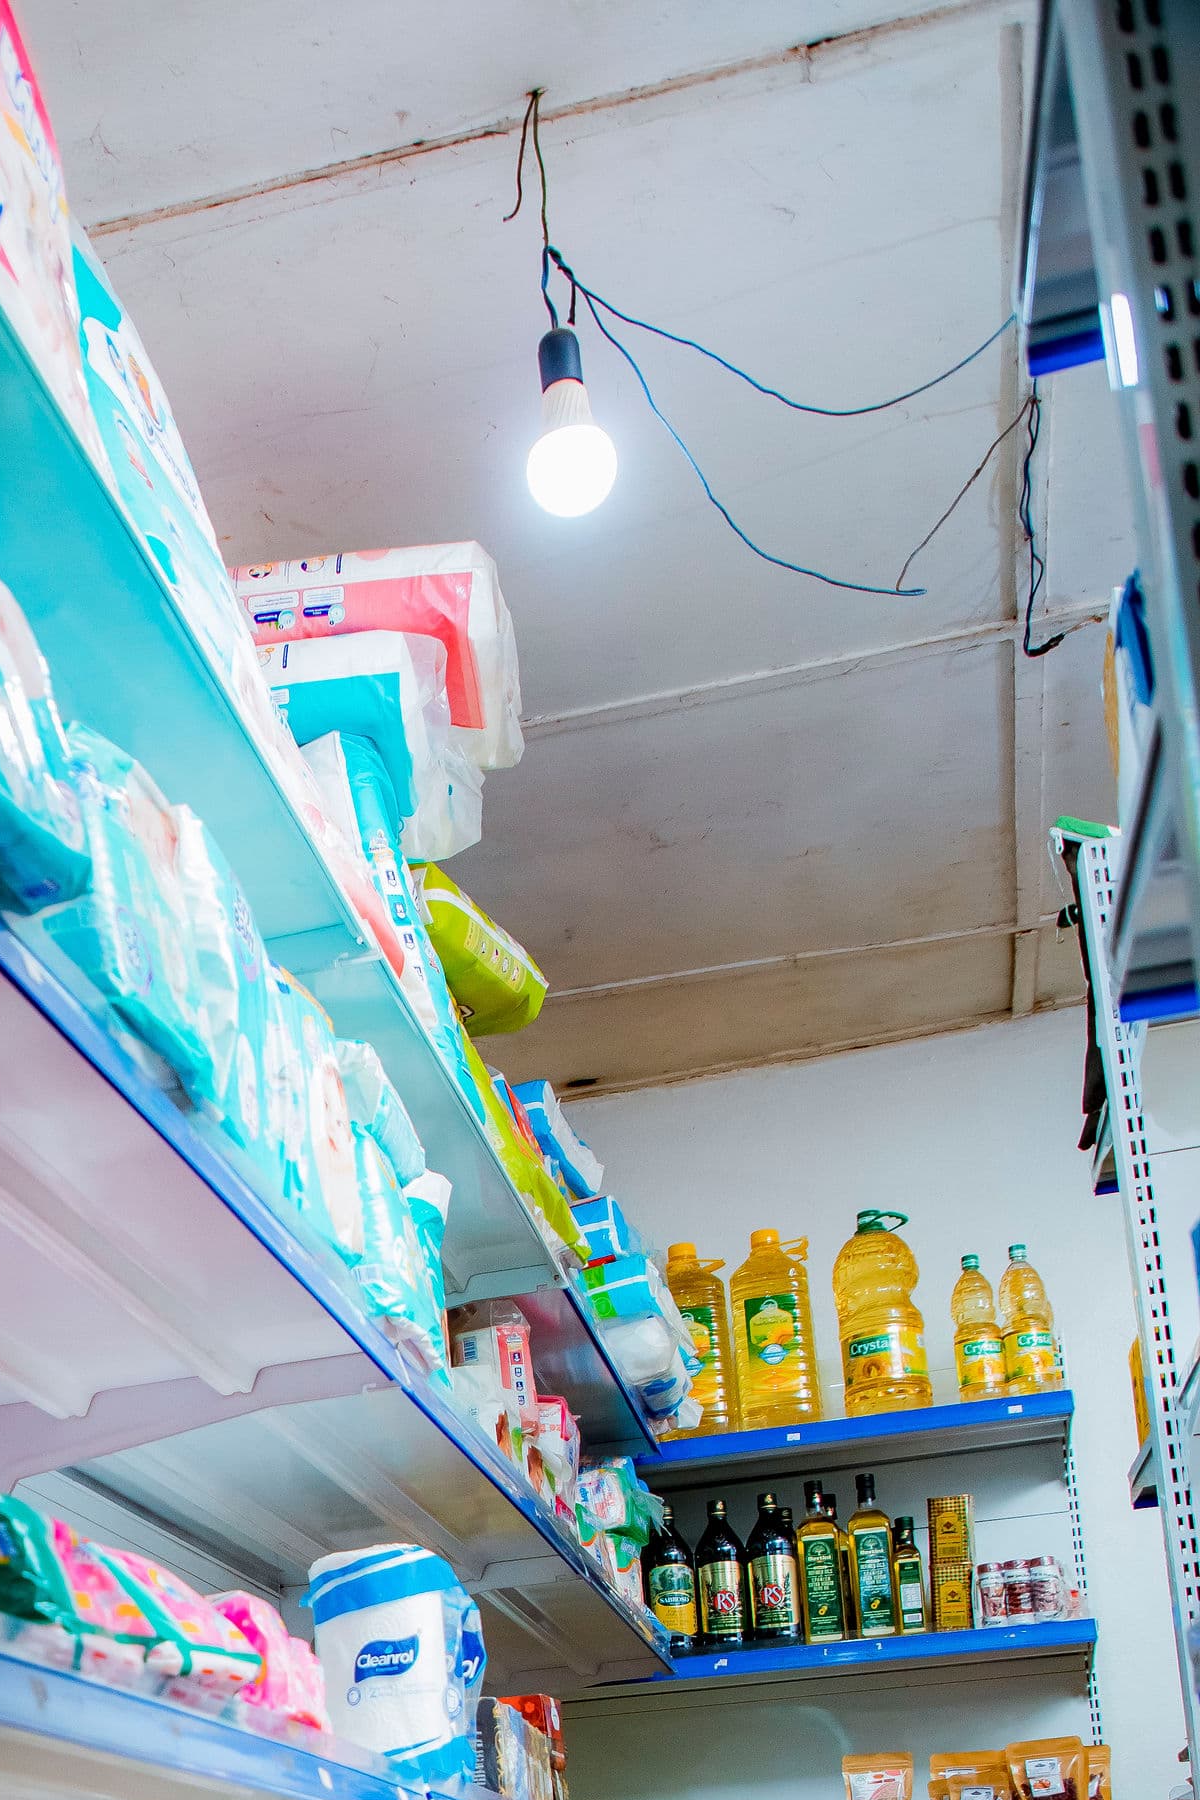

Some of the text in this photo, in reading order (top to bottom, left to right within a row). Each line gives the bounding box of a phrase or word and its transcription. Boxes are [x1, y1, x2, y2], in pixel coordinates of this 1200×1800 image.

[850, 1336, 894, 1356] Crysta
[716, 1591, 735, 1612] RS
[764, 1585, 782, 1605] RS
[356, 1649, 415, 1668] Cleanrol
